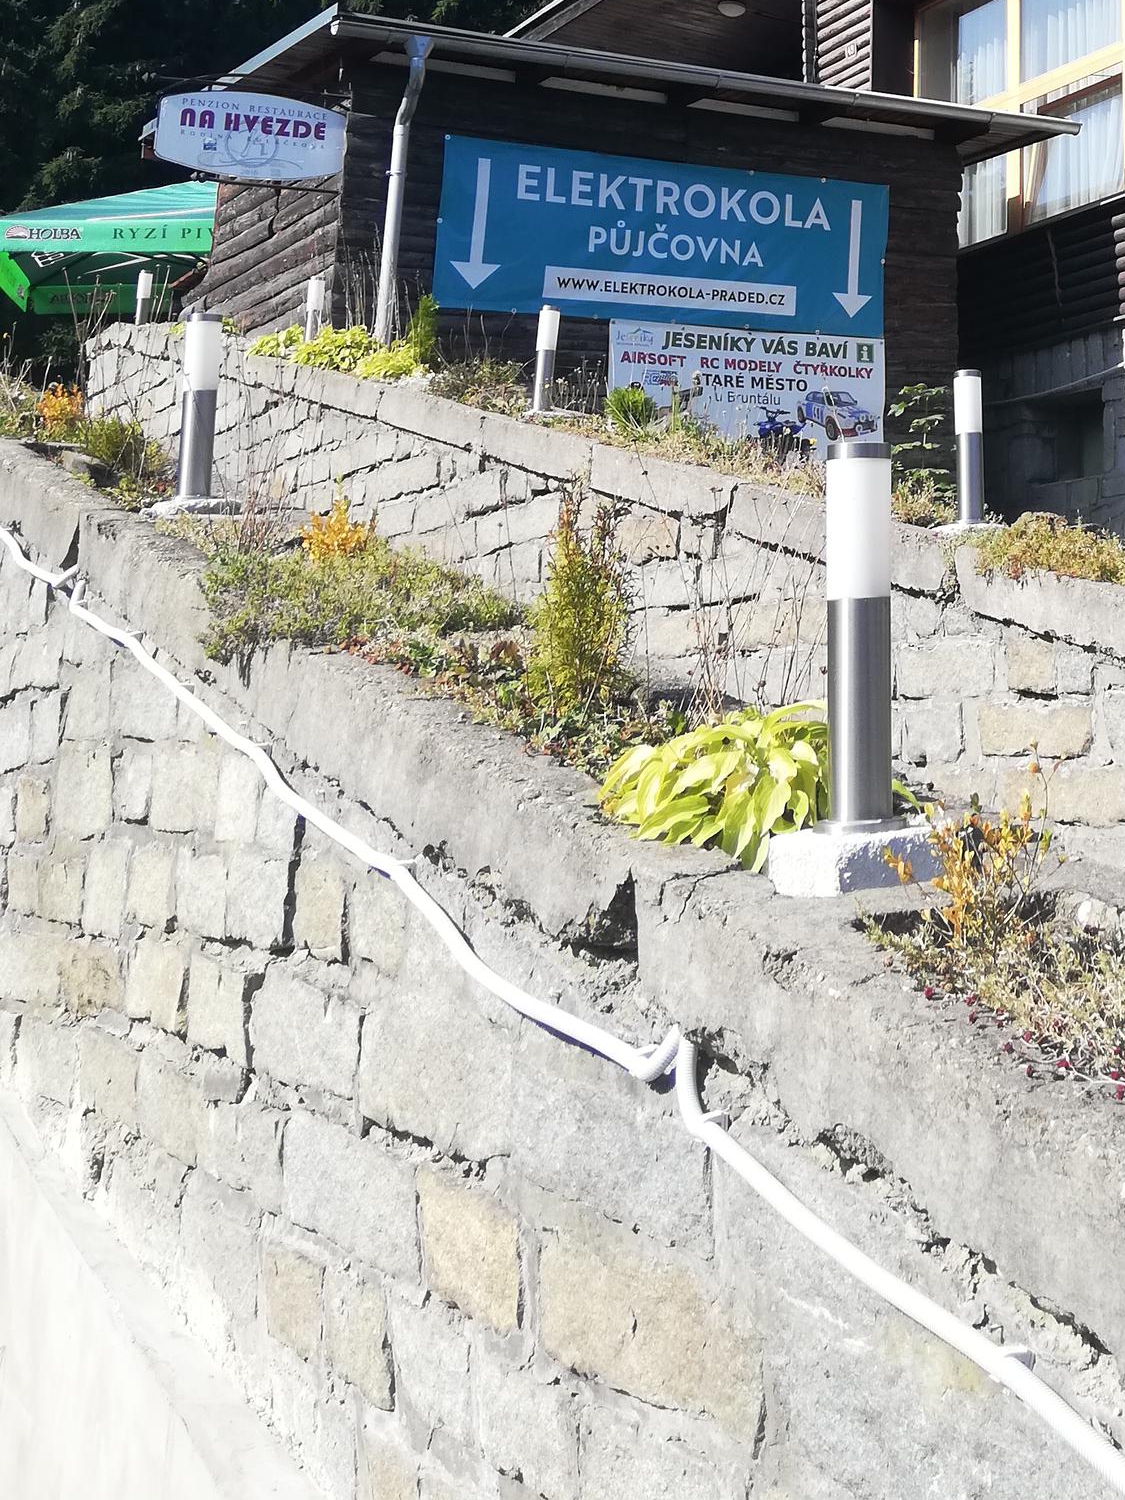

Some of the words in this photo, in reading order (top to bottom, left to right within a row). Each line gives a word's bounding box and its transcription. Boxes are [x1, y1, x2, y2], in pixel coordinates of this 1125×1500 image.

[180, 107, 215, 129] NA
[182, 97, 240, 111] PENZION
[249, 104, 327, 121] RESTAURACE
[516, 163, 832, 232] ELEKTROKOLA
[27, 227, 81, 240] HOLBA
[113, 224, 168, 240] RYZÍ
[588, 219, 764, 268] PŮJČOVNA
[556, 275, 785, 307] WWW.ELEKTROKOLA-PRADED.CZ
[661, 330, 757, 353] JESENÍKY
[761, 337, 798, 356] VÁS
[805, 341, 848, 359] BAVÍ
[620, 350, 687, 368] AIRSOFT
[700, 356, 719, 369] RC
[724, 359, 782, 374] MODELY
[793, 360, 874, 379] ČTYŘKOLKY
[751, 375, 808, 392] MĚSTO
